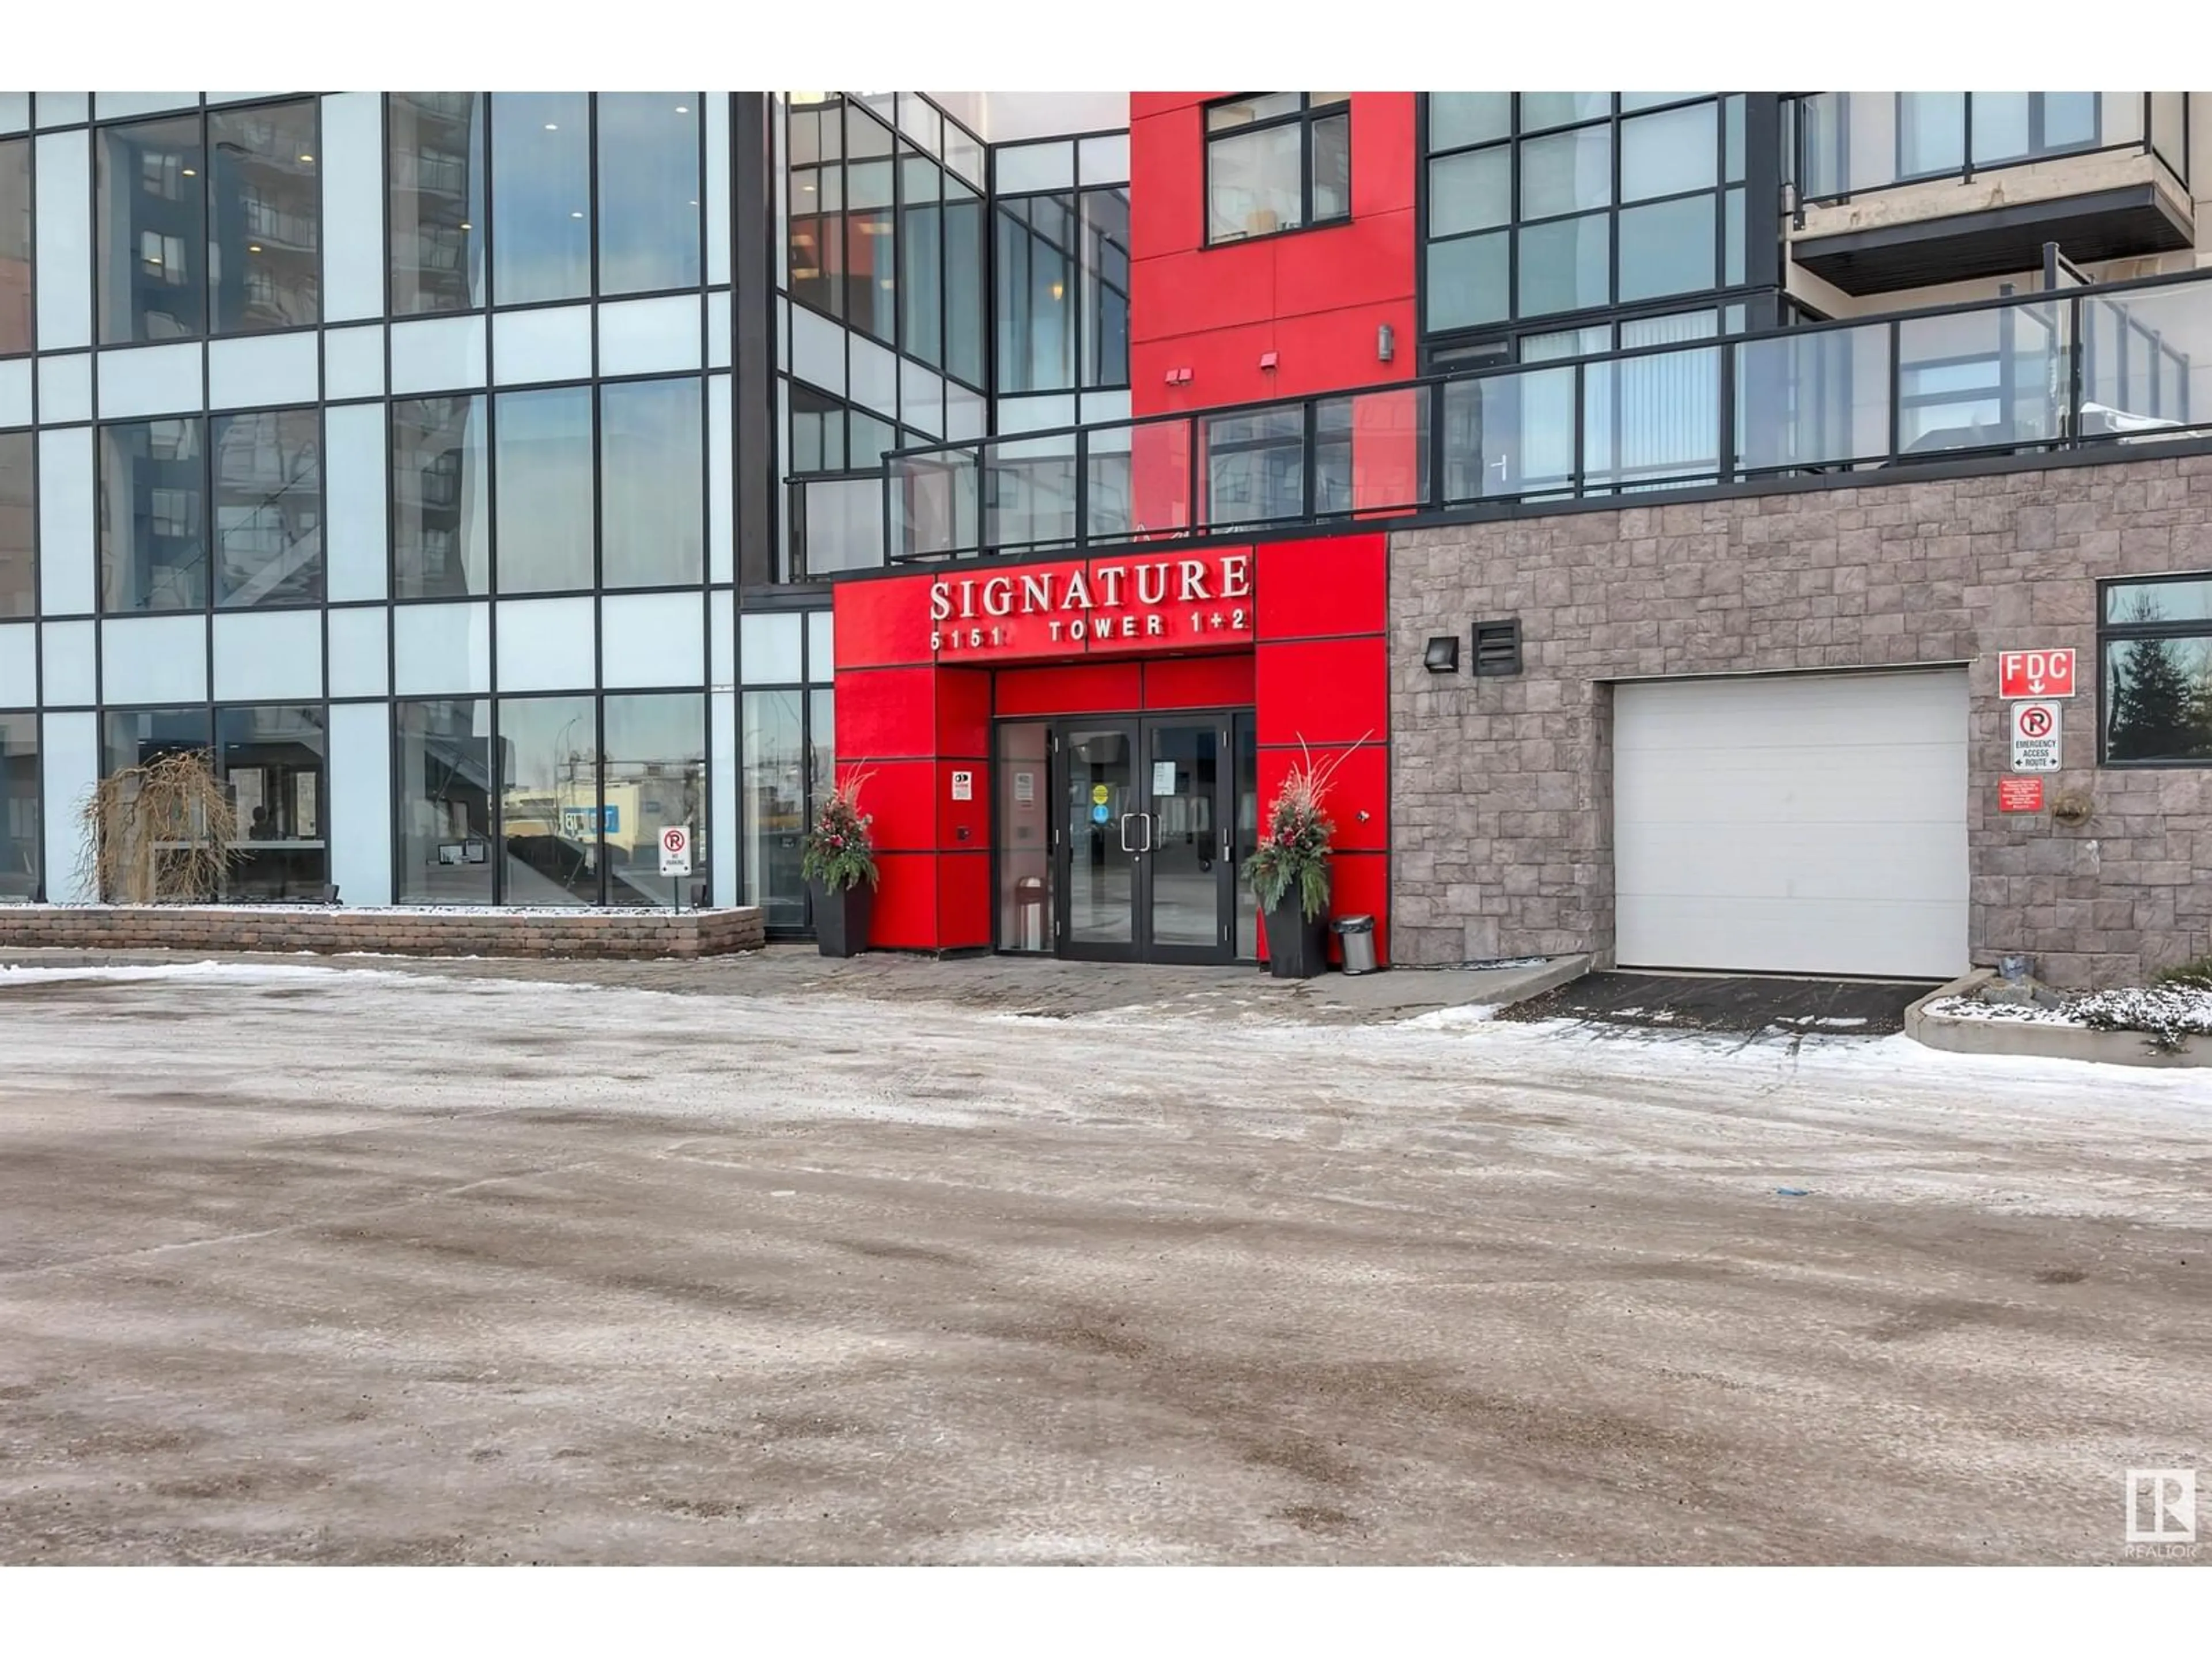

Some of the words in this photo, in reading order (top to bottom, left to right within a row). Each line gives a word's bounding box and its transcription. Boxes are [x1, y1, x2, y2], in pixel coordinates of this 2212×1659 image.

[930, 555, 1249, 620] SIGNATURE
[930, 626, 999, 650] 5151
[1049, 614, 1161, 641] TOWER
[1191, 608, 1244, 632] 1+2
[2006, 652, 2067, 681] FDC
[2016, 739, 2056, 748] EMERGENCY
[2022, 749, 2050, 757] ACCESS
[2025, 757, 2047, 767] ROUTE
